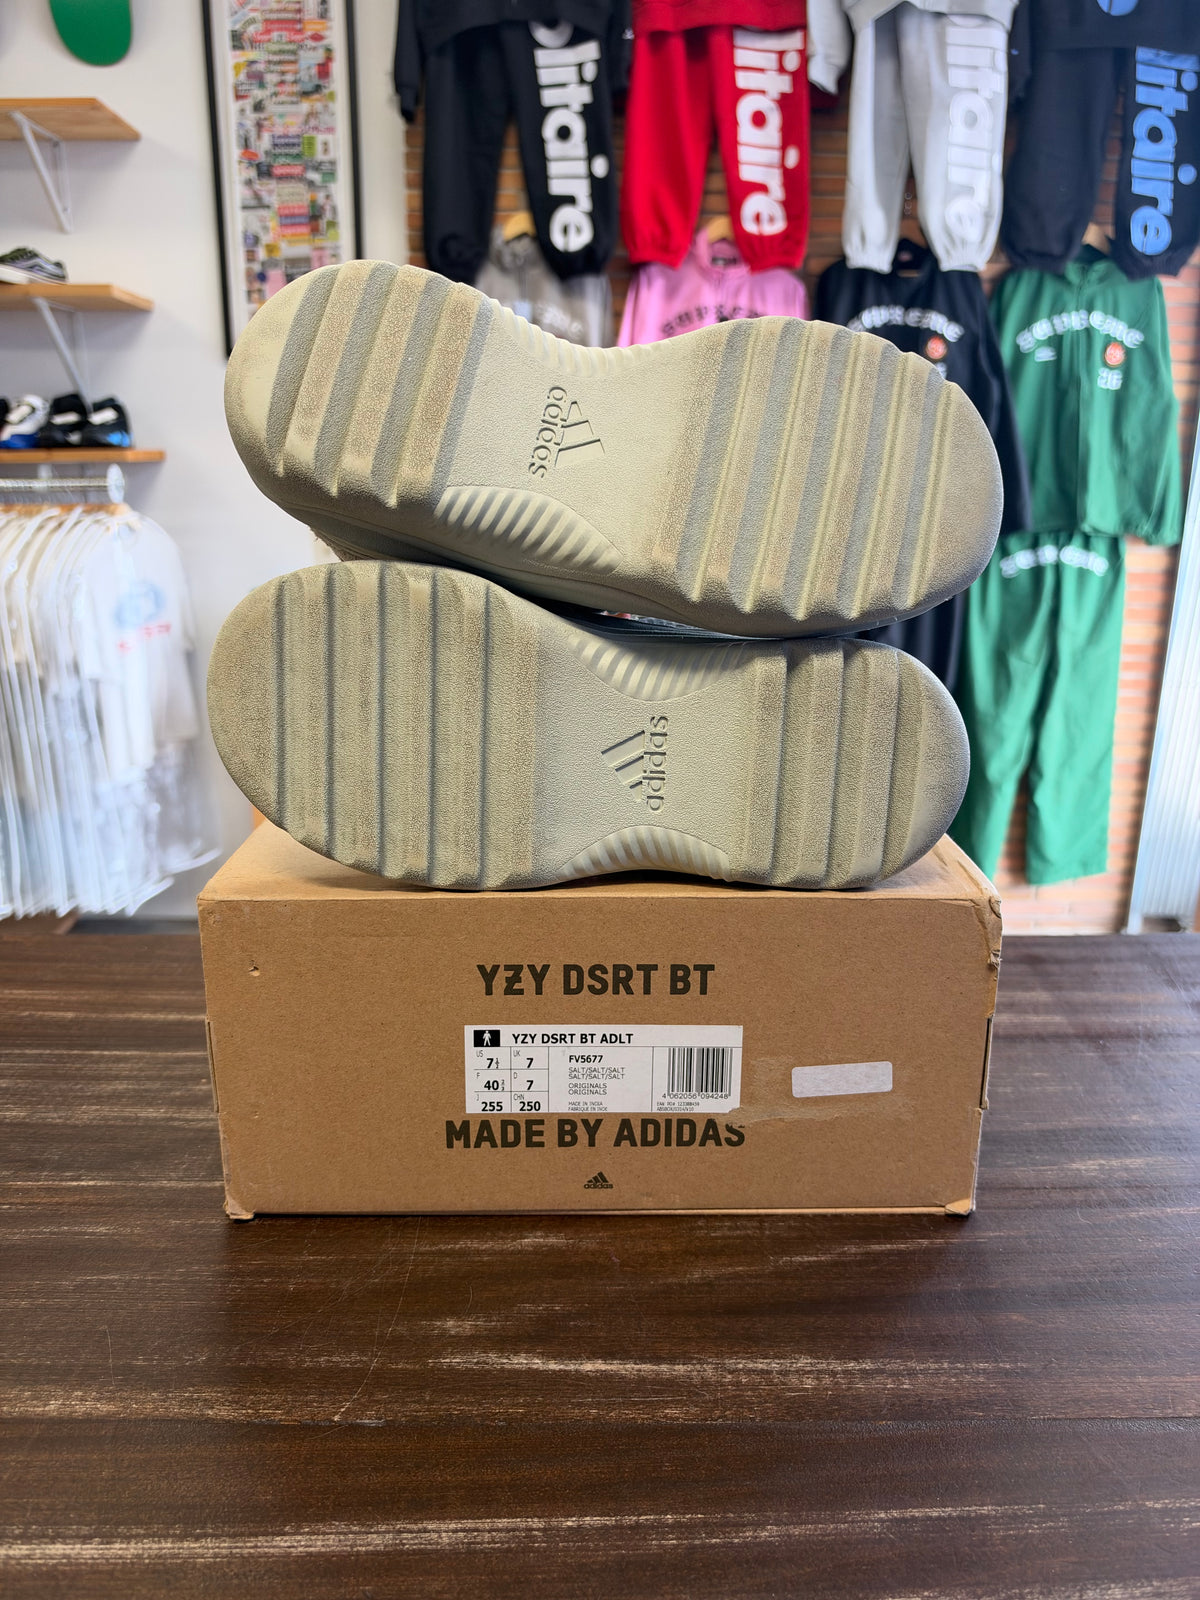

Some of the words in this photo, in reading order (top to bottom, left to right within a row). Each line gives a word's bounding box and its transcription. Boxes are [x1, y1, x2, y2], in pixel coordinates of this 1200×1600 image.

[944, 15, 1008, 243] litaire
[528, 386, 568, 479] adidas
[642, 715, 669, 812] adidas
[563, 963, 659, 995] DSRT
[669, 964, 716, 995] BT
[512, 1033, 537, 1044] YZY
[541, 1033, 576, 1044] DSRT
[580, 1033, 596, 1044] BT
[600, 1033, 634, 1044] ADLT
[526, 1057, 534, 1069] 7
[568, 1054, 604, 1064] FV5677
[568, 1066, 626, 1075] SALT/SALT/SALT
[568, 1073, 626, 1081] SALT/SALT/SALT
[526, 1079, 534, 1091] 7
[481, 1101, 504, 1112] 255
[519, 1101, 541, 1112] 250
[445, 1119, 546, 1149] MADE
[557, 1118, 604, 1148] BY
[613, 1118, 746, 1148] ADIDAS
